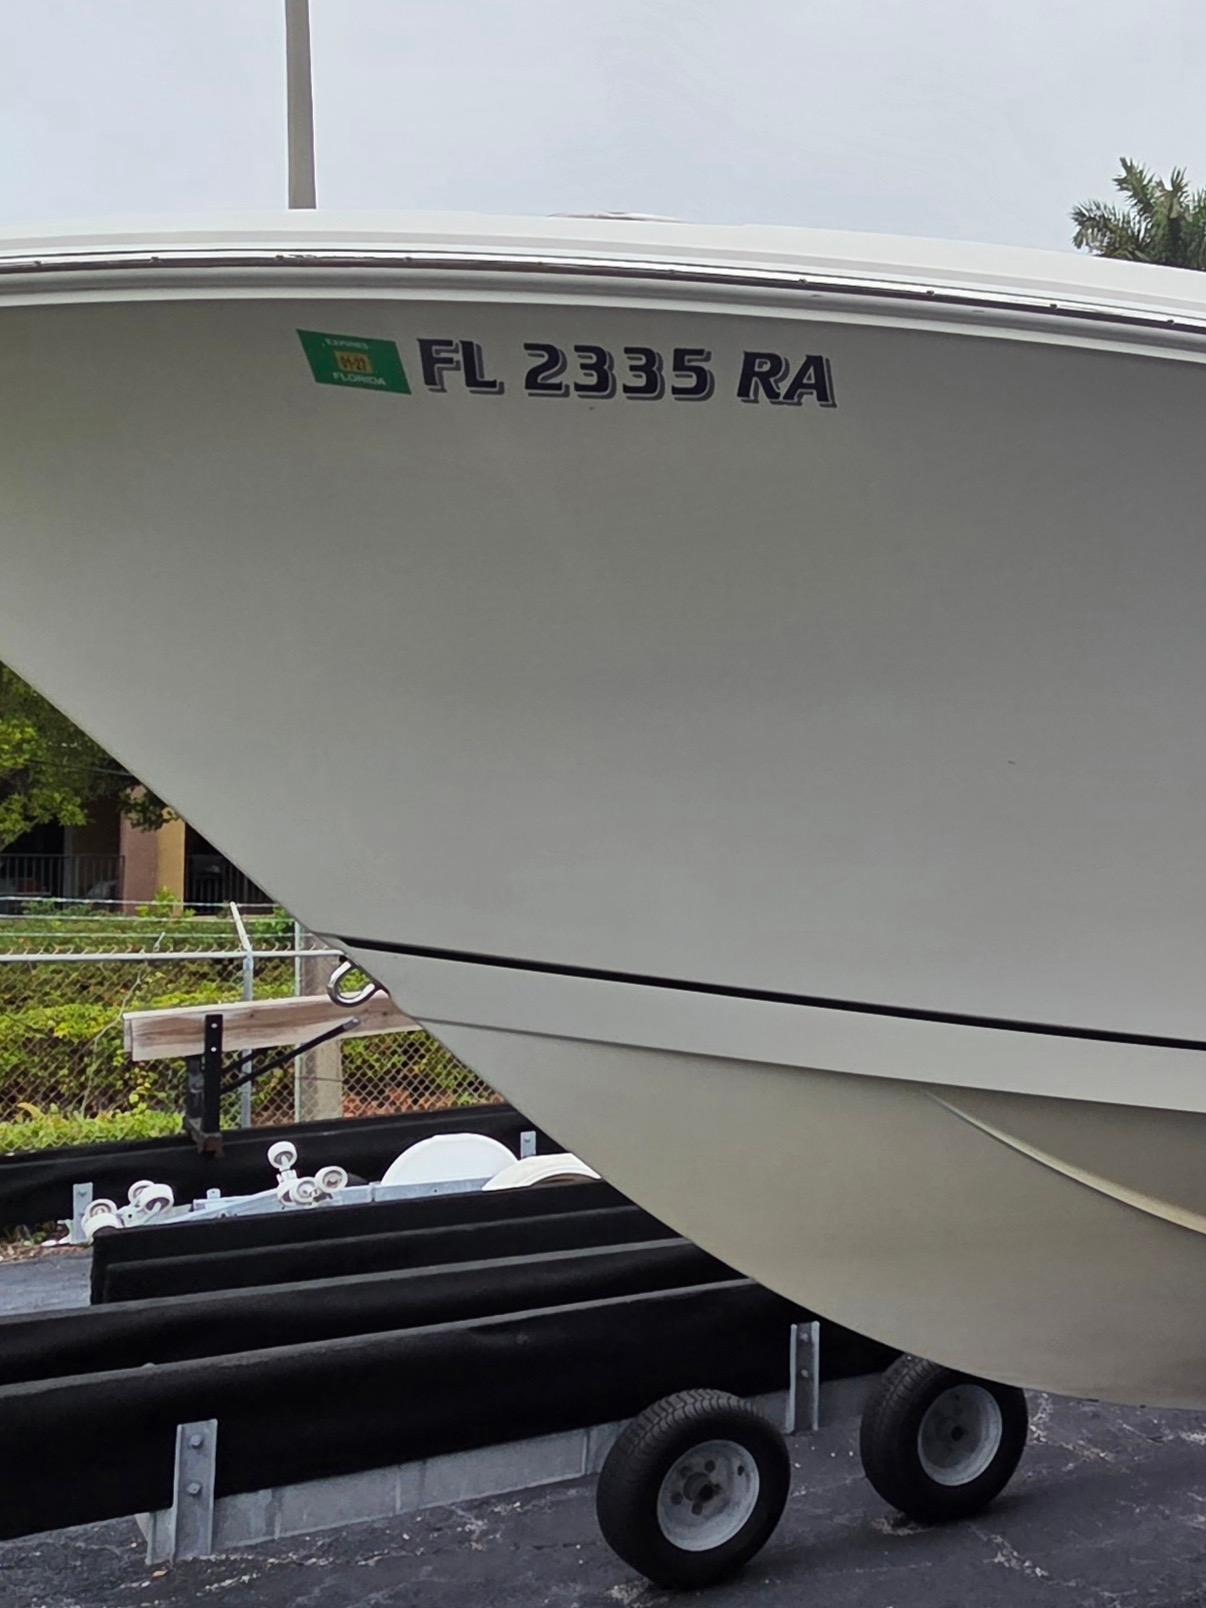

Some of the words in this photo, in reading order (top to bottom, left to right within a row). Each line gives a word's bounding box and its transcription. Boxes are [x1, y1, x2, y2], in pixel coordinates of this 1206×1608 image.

[332, 372, 387, 386] FLORIDA
[417, 338, 505, 395] FL
[523, 342, 717, 402] 2335
[736, 350, 838, 408] RA
